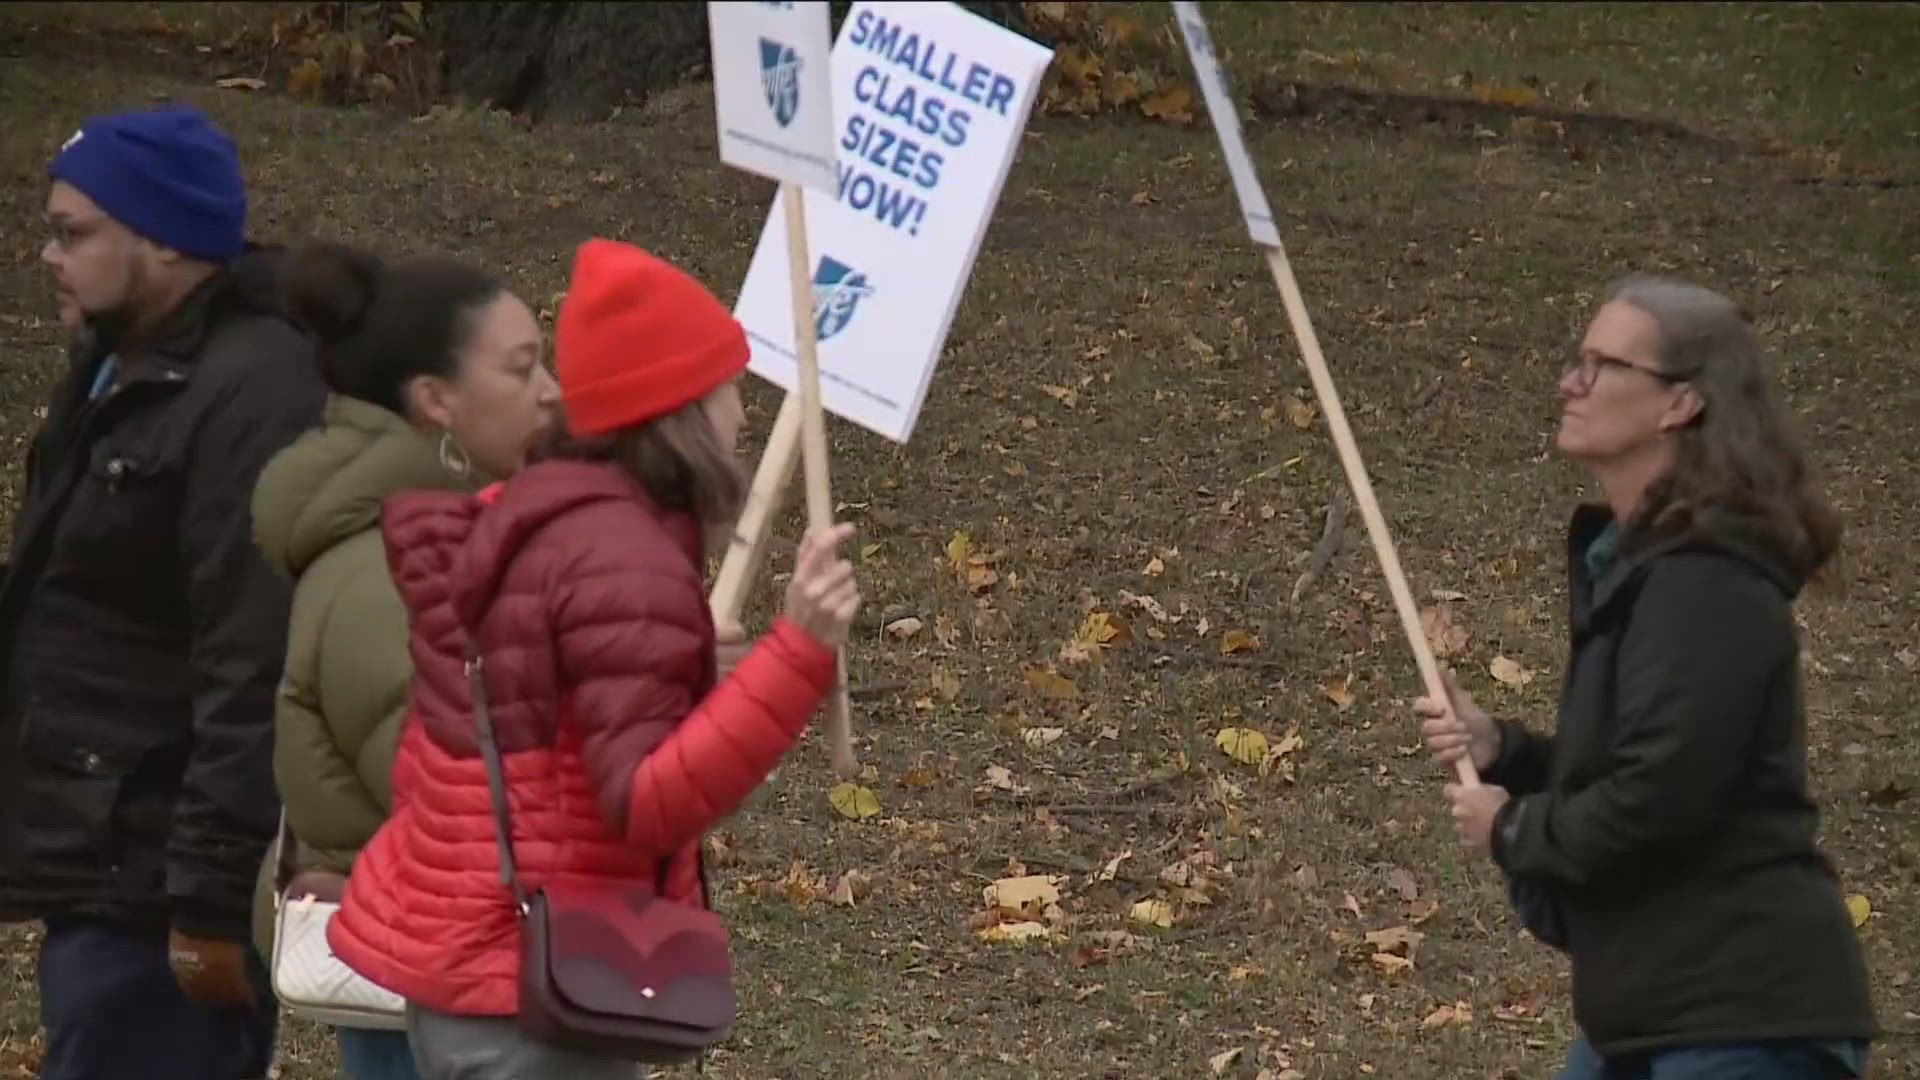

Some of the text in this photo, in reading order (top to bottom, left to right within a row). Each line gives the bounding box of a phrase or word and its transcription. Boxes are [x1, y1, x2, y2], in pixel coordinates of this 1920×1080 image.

[849, 9, 1016, 117] SMALLER
[854, 65, 971, 148] CLASS
[841, 114, 945, 189] SIZES
